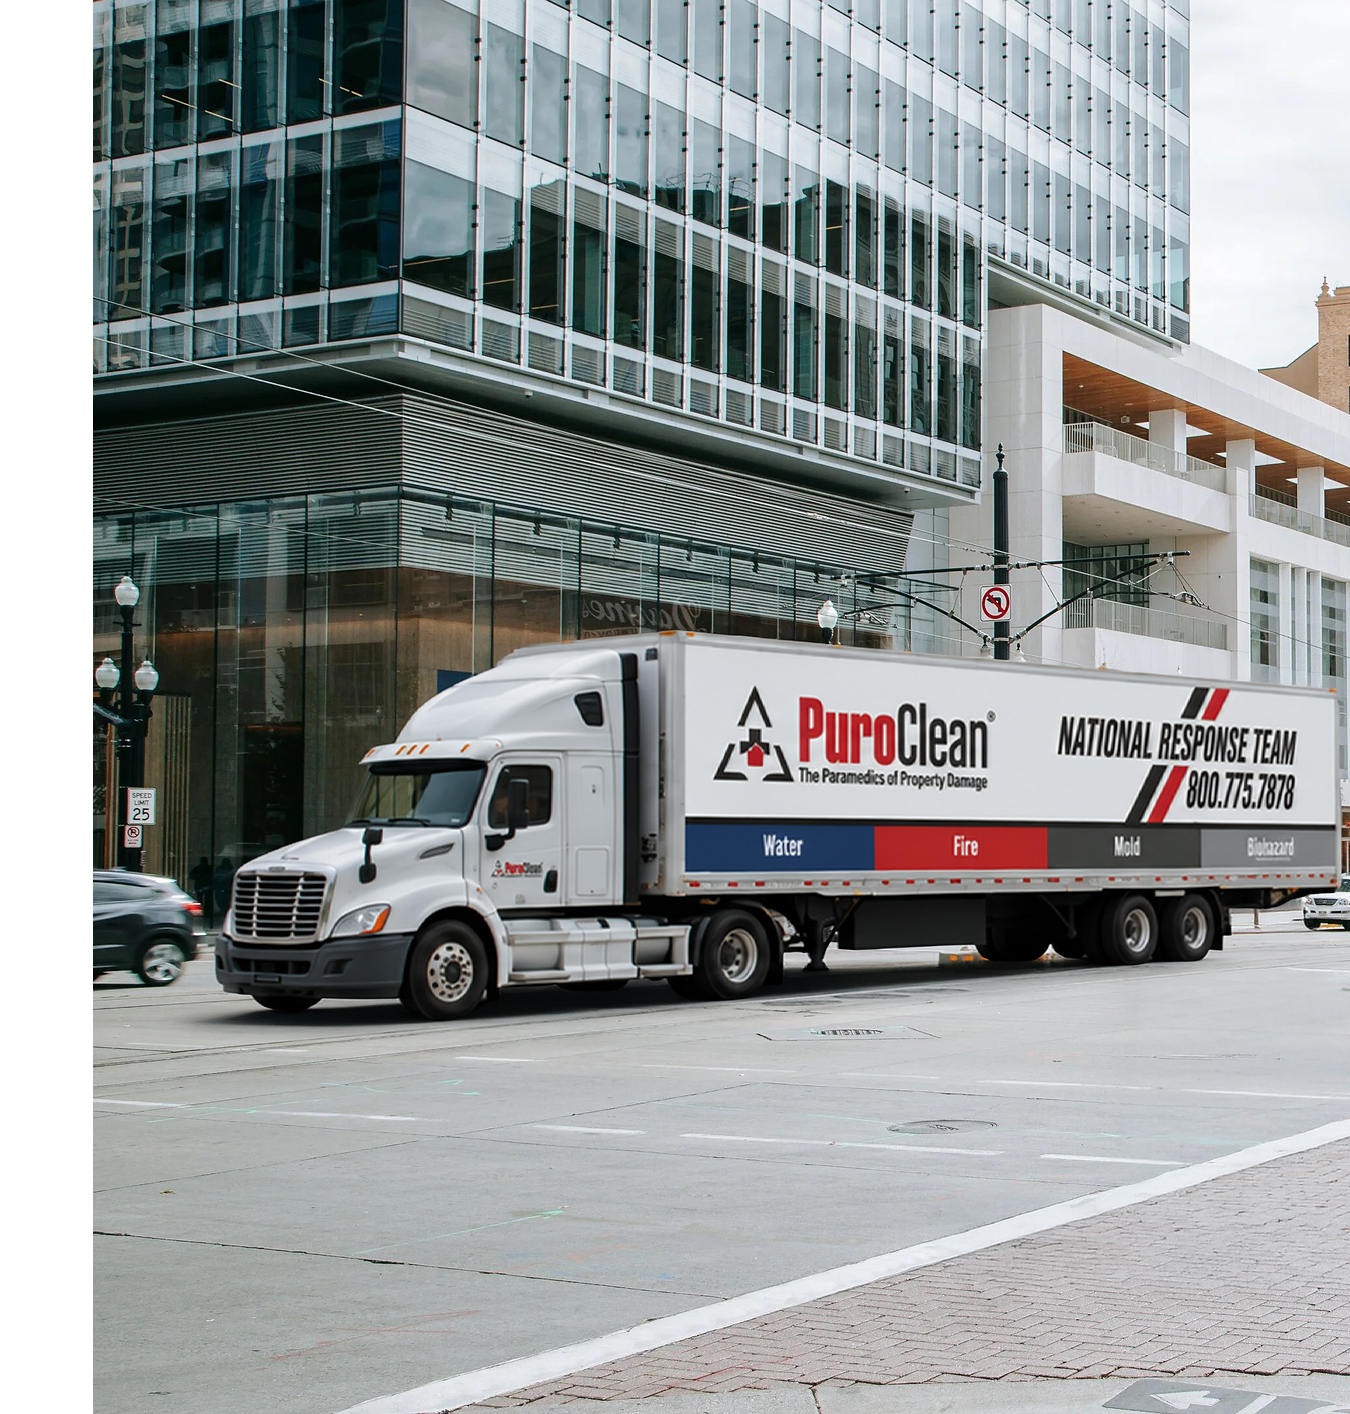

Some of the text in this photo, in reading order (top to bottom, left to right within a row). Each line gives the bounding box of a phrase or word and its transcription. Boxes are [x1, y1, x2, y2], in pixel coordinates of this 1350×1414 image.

[1057, 716, 1298, 766] NATIONAL RESPONSE TEAM
[799, 767, 988, 792] The Paramedics of Property Damage
[1186, 770, 1297, 811] 800.775.7878
[132, 808, 150, 821] 25
[763, 834, 803, 857] Water
[953, 836, 979, 856] Fire
[1114, 836, 1141, 857] Mold
[1247, 837, 1295, 857] Biohazard
